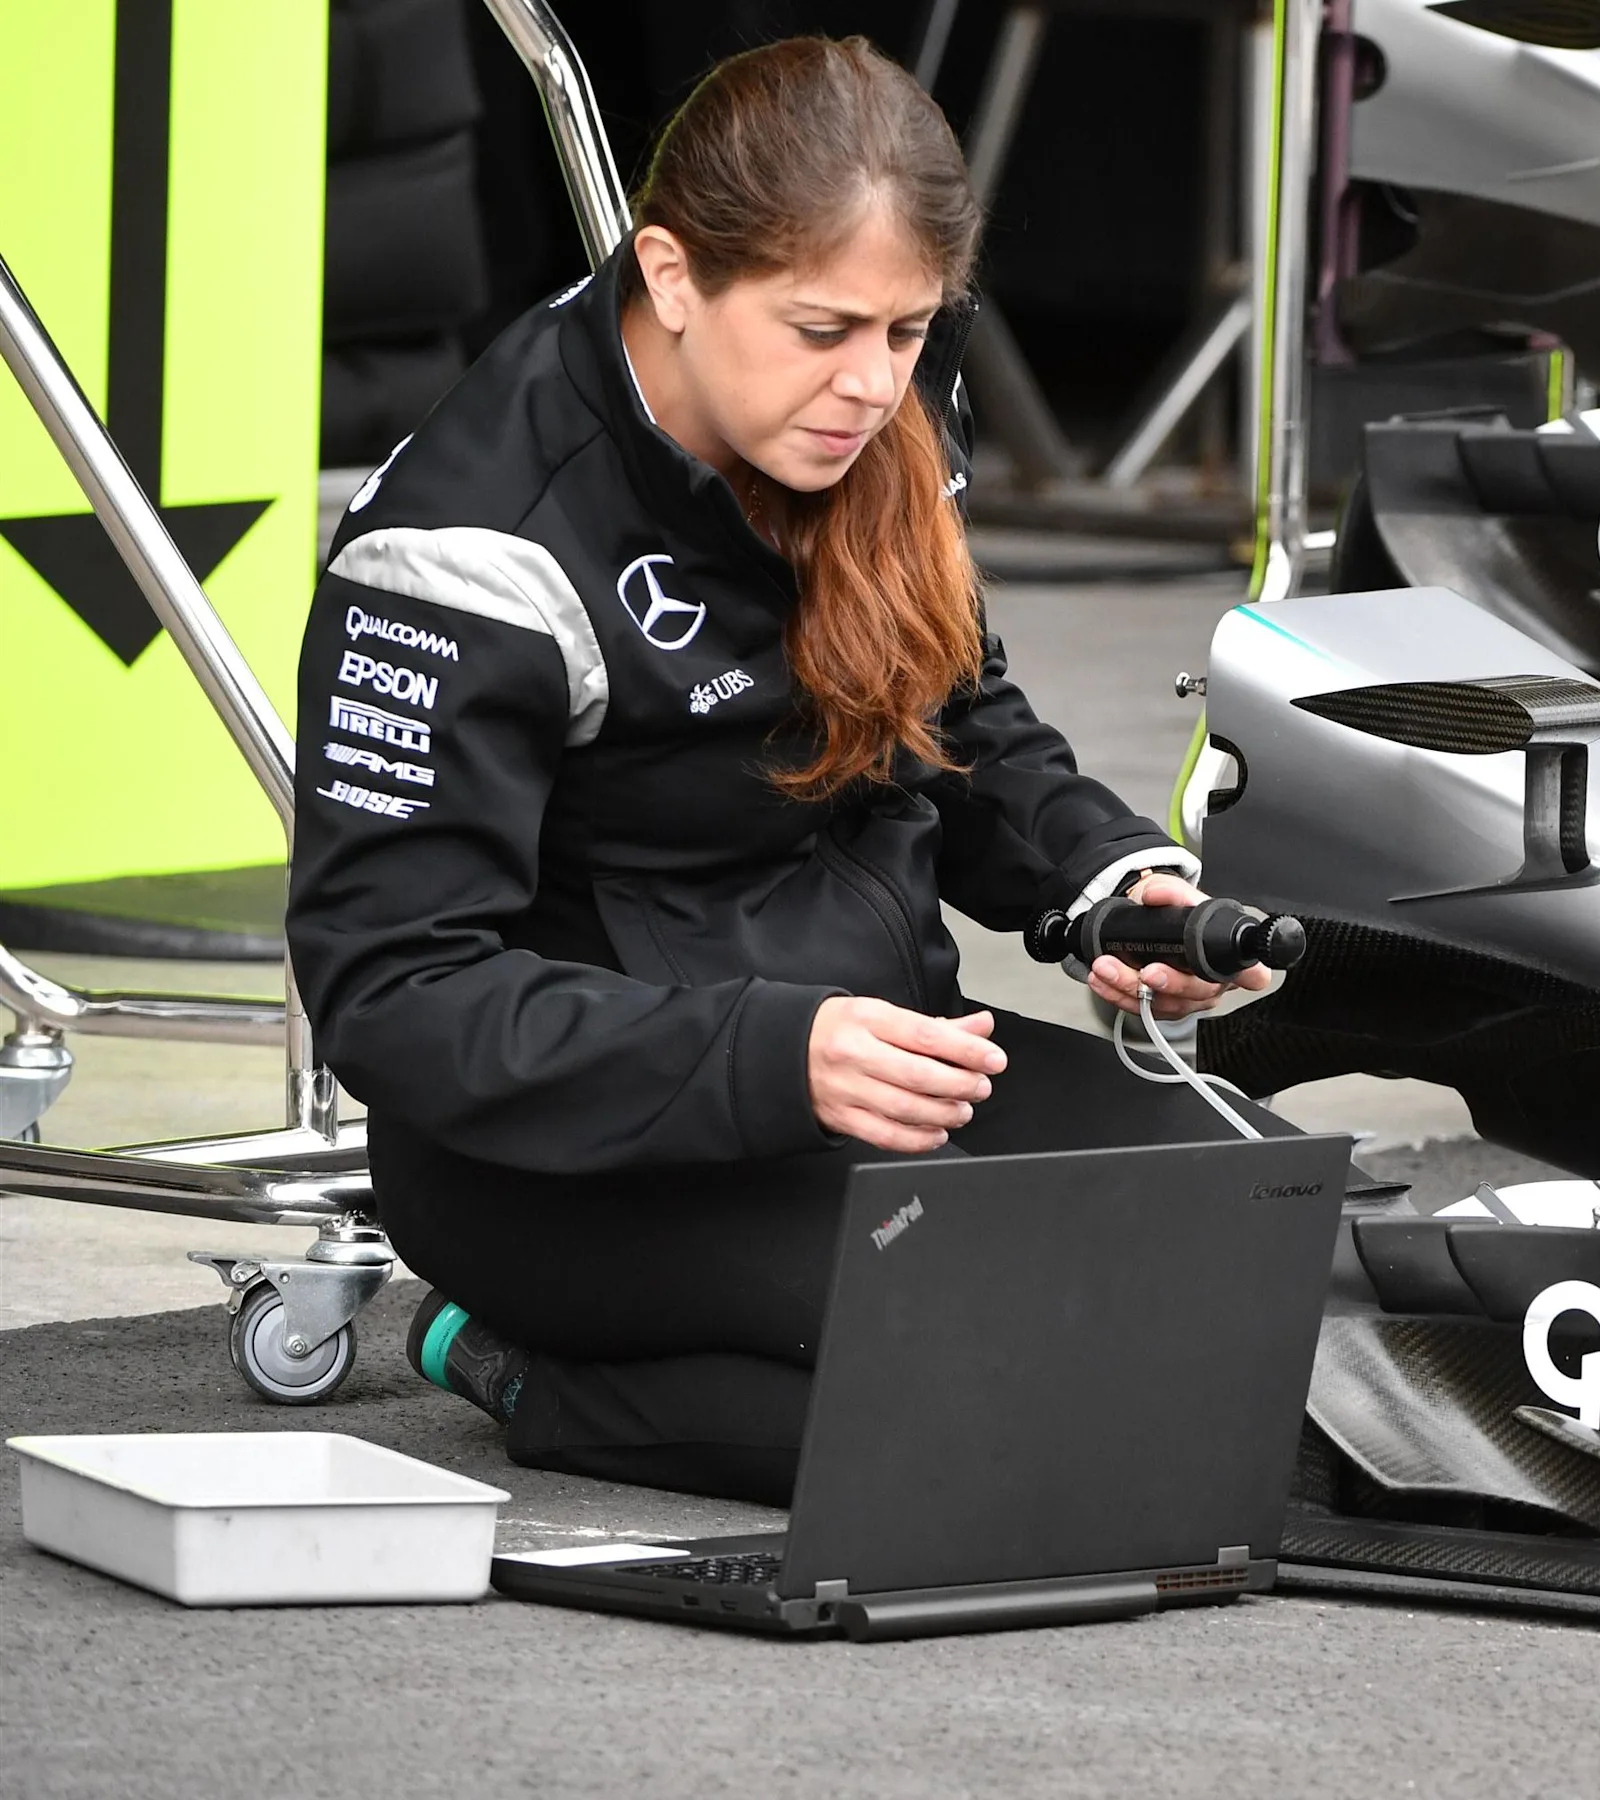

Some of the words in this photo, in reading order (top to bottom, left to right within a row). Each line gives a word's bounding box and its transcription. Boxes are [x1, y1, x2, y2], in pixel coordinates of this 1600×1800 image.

[345, 606, 459, 662] QUALCOMM
[338, 650, 438, 709] EPSON
[711, 669, 755, 700] UBS
[329, 695, 432, 753] PIRELLI
[349, 749, 436, 787] AMG
[316, 780, 431, 819] BOSE
[870, 1194, 924, 1251] ThinkPad
